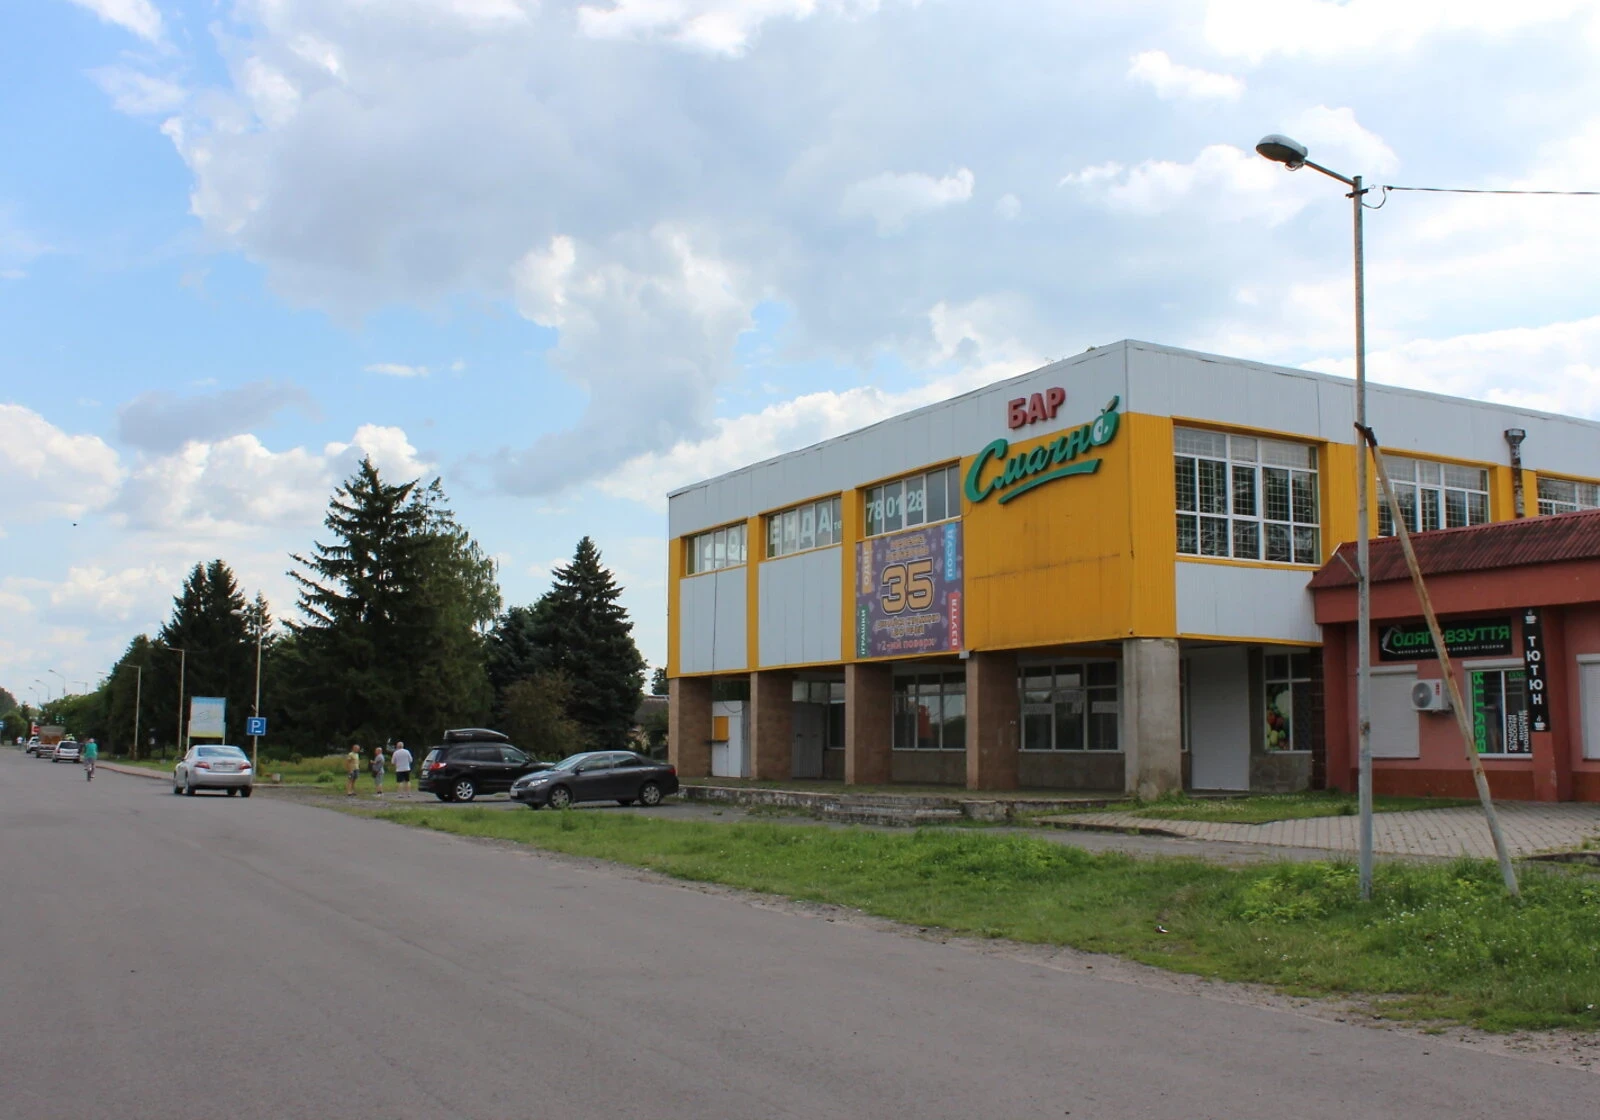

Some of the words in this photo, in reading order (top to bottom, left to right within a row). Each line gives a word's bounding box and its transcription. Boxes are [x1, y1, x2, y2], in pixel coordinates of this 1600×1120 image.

[1008, 387, 1065, 429] БАР
[881, 557, 934, 615] 35
[1445, 625, 1510, 643] ВЗУТТЯ
[1526, 636, 1544, 705] ТЮТЮН
[1472, 671, 1486, 753] ВЗУТТЯ
